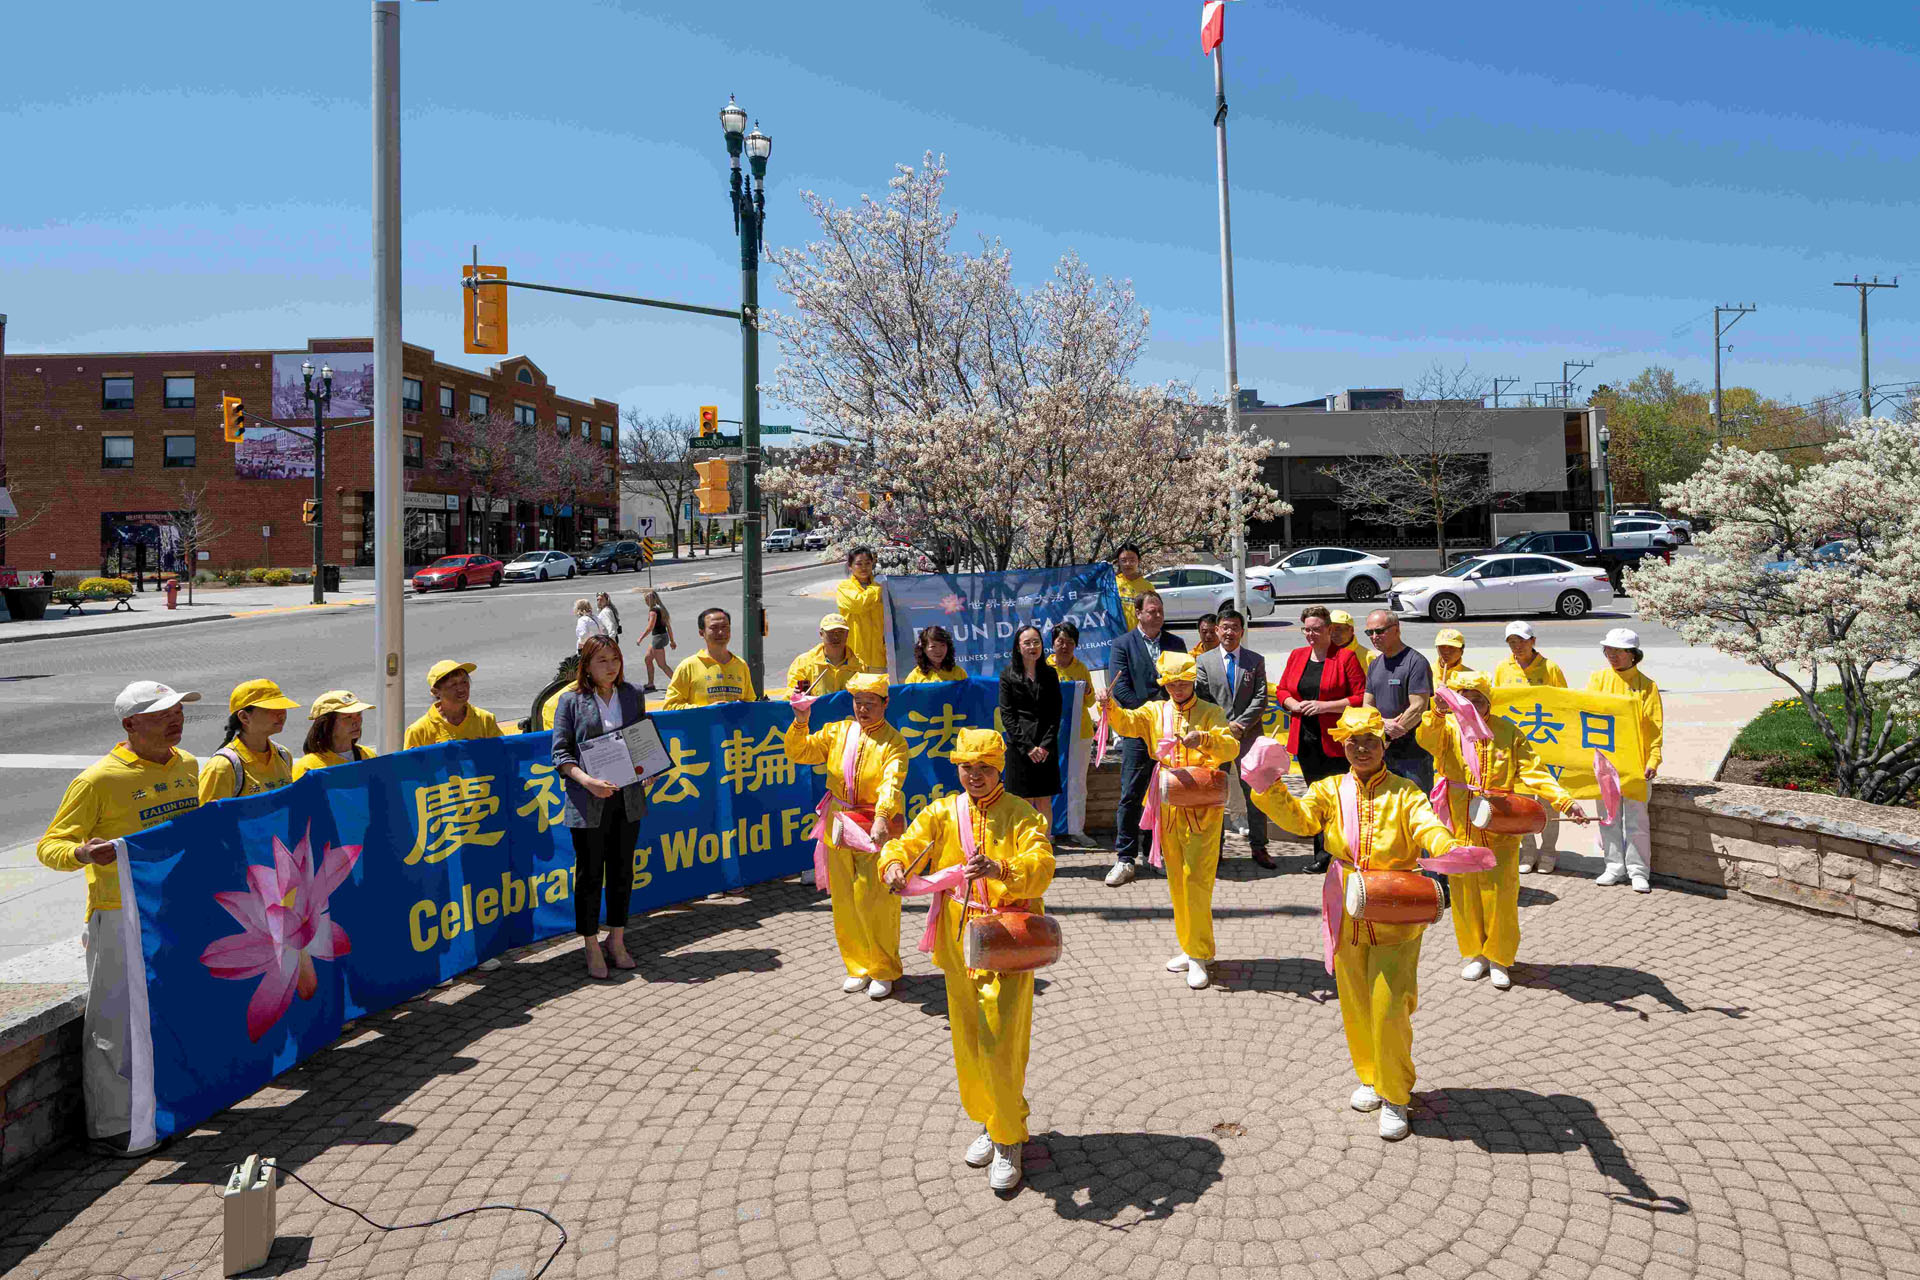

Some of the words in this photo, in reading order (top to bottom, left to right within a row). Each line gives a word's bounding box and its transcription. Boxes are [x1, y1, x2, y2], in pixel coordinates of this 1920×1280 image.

[695, 439, 724, 447] SECOND
[913, 622, 989, 646] FUN
[955, 653, 988, 663] FULNESS
[1076, 640, 1112, 651] OLERANC
[143, 802, 178, 819] FALUN
[408, 845, 653, 953] Celebrag
[660, 813, 765, 874] World
